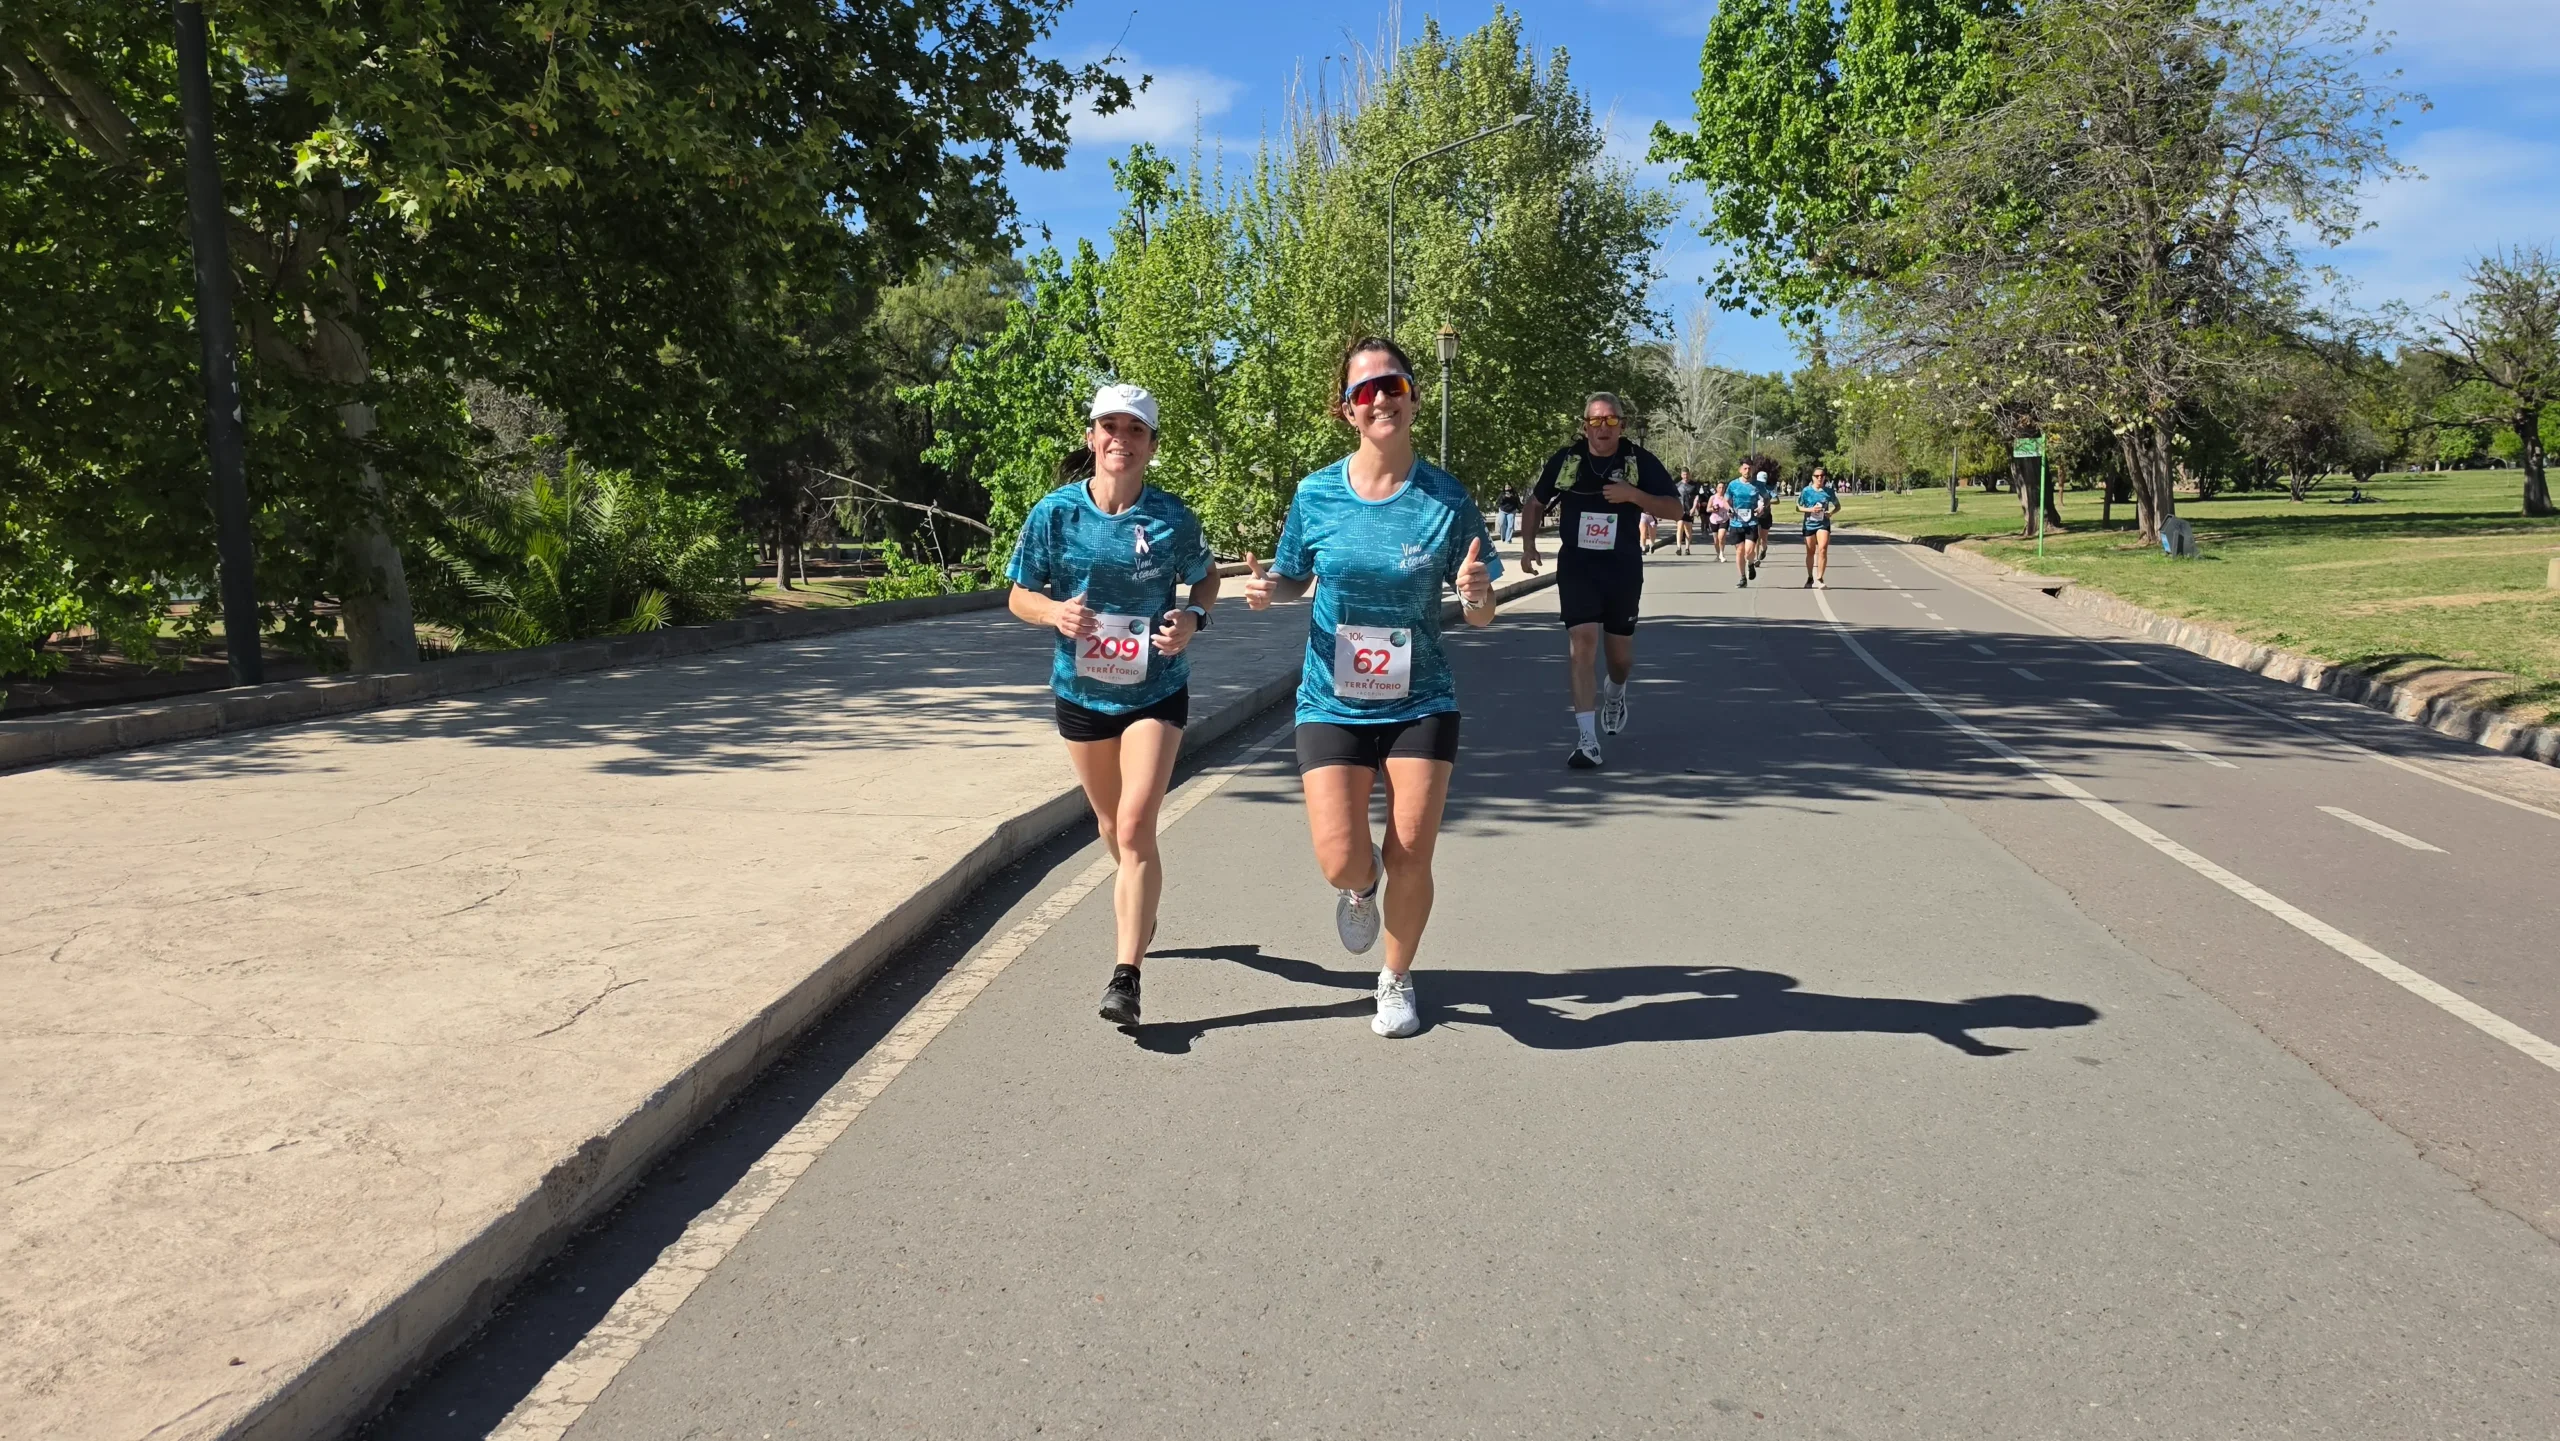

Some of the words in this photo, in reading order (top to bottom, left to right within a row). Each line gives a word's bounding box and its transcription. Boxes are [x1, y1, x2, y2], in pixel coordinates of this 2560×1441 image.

[1586, 524, 1609, 537] 194
[1349, 632, 1364, 641] 10k
[1082, 635, 1140, 661] 209
[1353, 648, 1391, 675] 62
[1086, 664, 1139, 675] TERRITORIO
[1345, 679, 1401, 690] TERRITORIO
